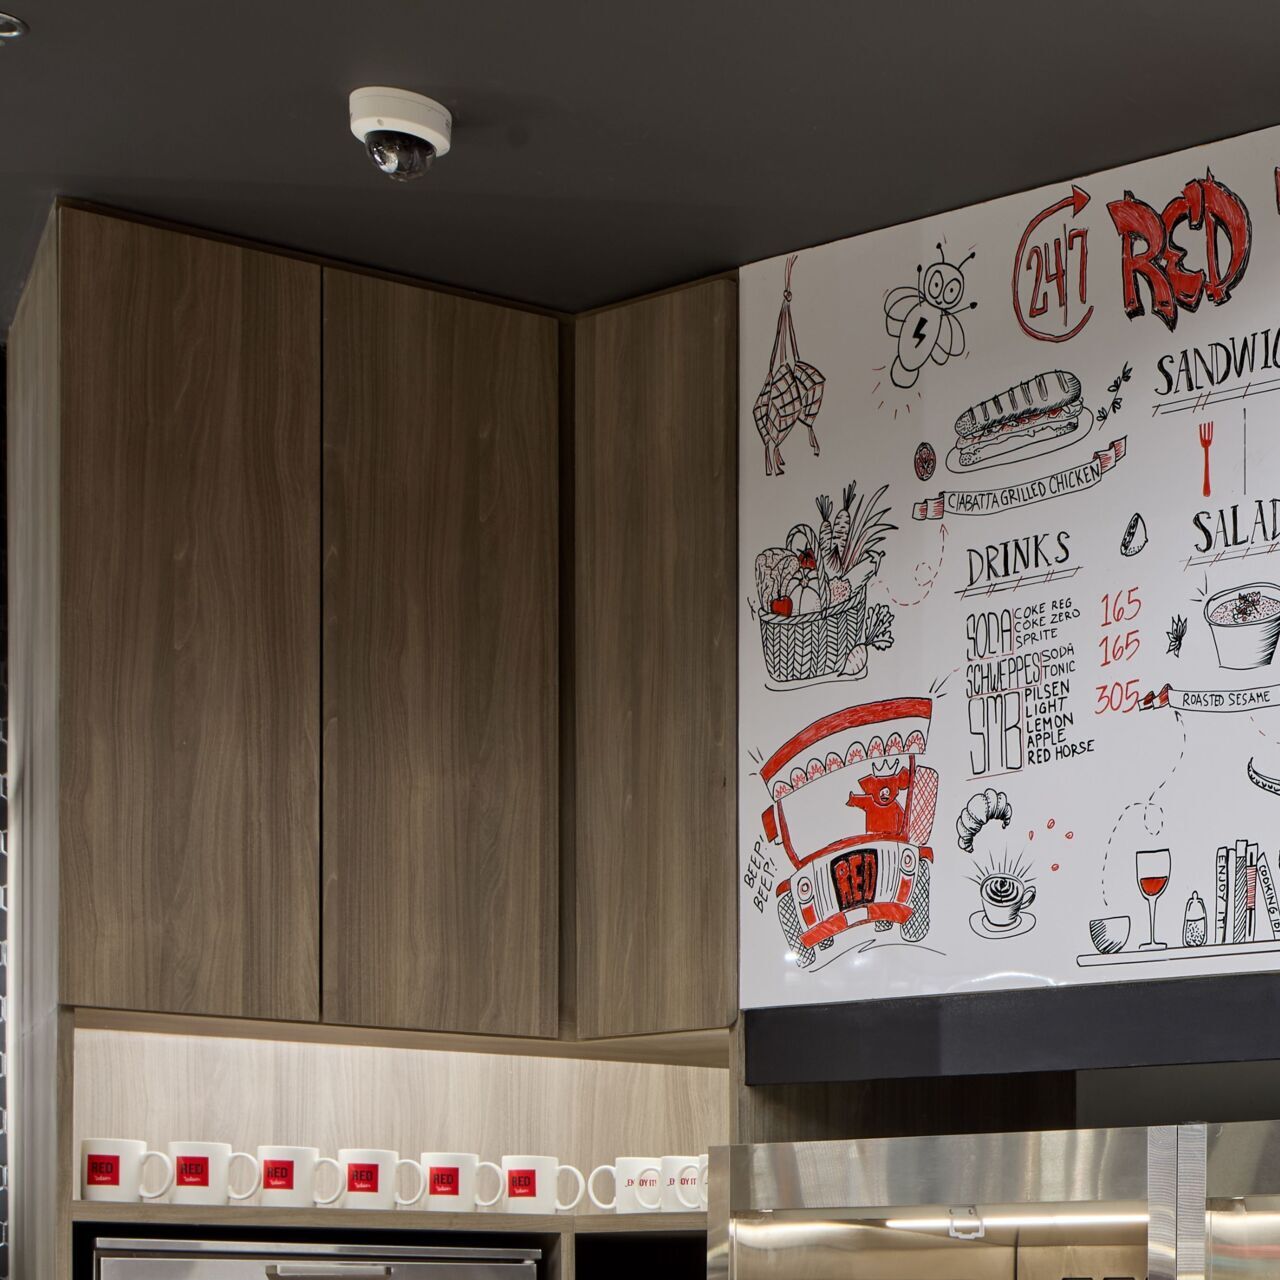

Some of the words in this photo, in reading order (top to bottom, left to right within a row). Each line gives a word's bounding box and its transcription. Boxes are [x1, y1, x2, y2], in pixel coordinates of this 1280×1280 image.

[1106, 166, 1252, 332] RED
[949, 492, 1000, 512] CIABATTA
[1000, 481, 1047, 506] GRILLED
[1049, 463, 1101, 495] CHICKEN
[966, 530, 1071, 587] DRINKS
[1013, 602, 1046, 620] COKE
[1051, 597, 1073, 611] REG
[1100, 586, 1143, 627] 165
[1013, 616, 1046, 634] COKE
[1050, 608, 1082, 624] ZERO
[966, 608, 1013, 662] SODA
[1015, 628, 1059, 650] SPRITE
[1041, 643, 1075, 663] SODA
[1098, 629, 1141, 668] 165
[966, 652, 1042, 698] SCHWEPPES
[1041, 660, 1077, 680] TONIC
[1024, 678, 1070, 703] PILSEN
[1094, 678, 1141, 715] 305
[1183, 692, 1225, 708] ROASTED
[1228, 690, 1271, 706] SESAME
[1025, 696, 1068, 719] LIGHT
[967, 691, 1024, 776] SMB
[1026, 711, 1075, 735] LEMON
[1026, 727, 1067, 749] APPLE
[1027, 747, 1051, 766] RED
[1055, 739, 1096, 760] HORSE
[743, 834, 765, 889] BEEP!
[752, 857, 779, 914] BEEP!
[833, 853, 877, 909] RED
[1218, 854, 1228, 903] ENJOY
[1258, 864, 1279, 915] COOKING
[91, 1161, 113, 1174] RED
[181, 1162, 204, 1175] RED
[267, 1166, 289, 1179] RED
[352, 1169, 374, 1182] RED
[433, 1173, 454, 1185] RED
[511, 1175, 531, 1187] RED
